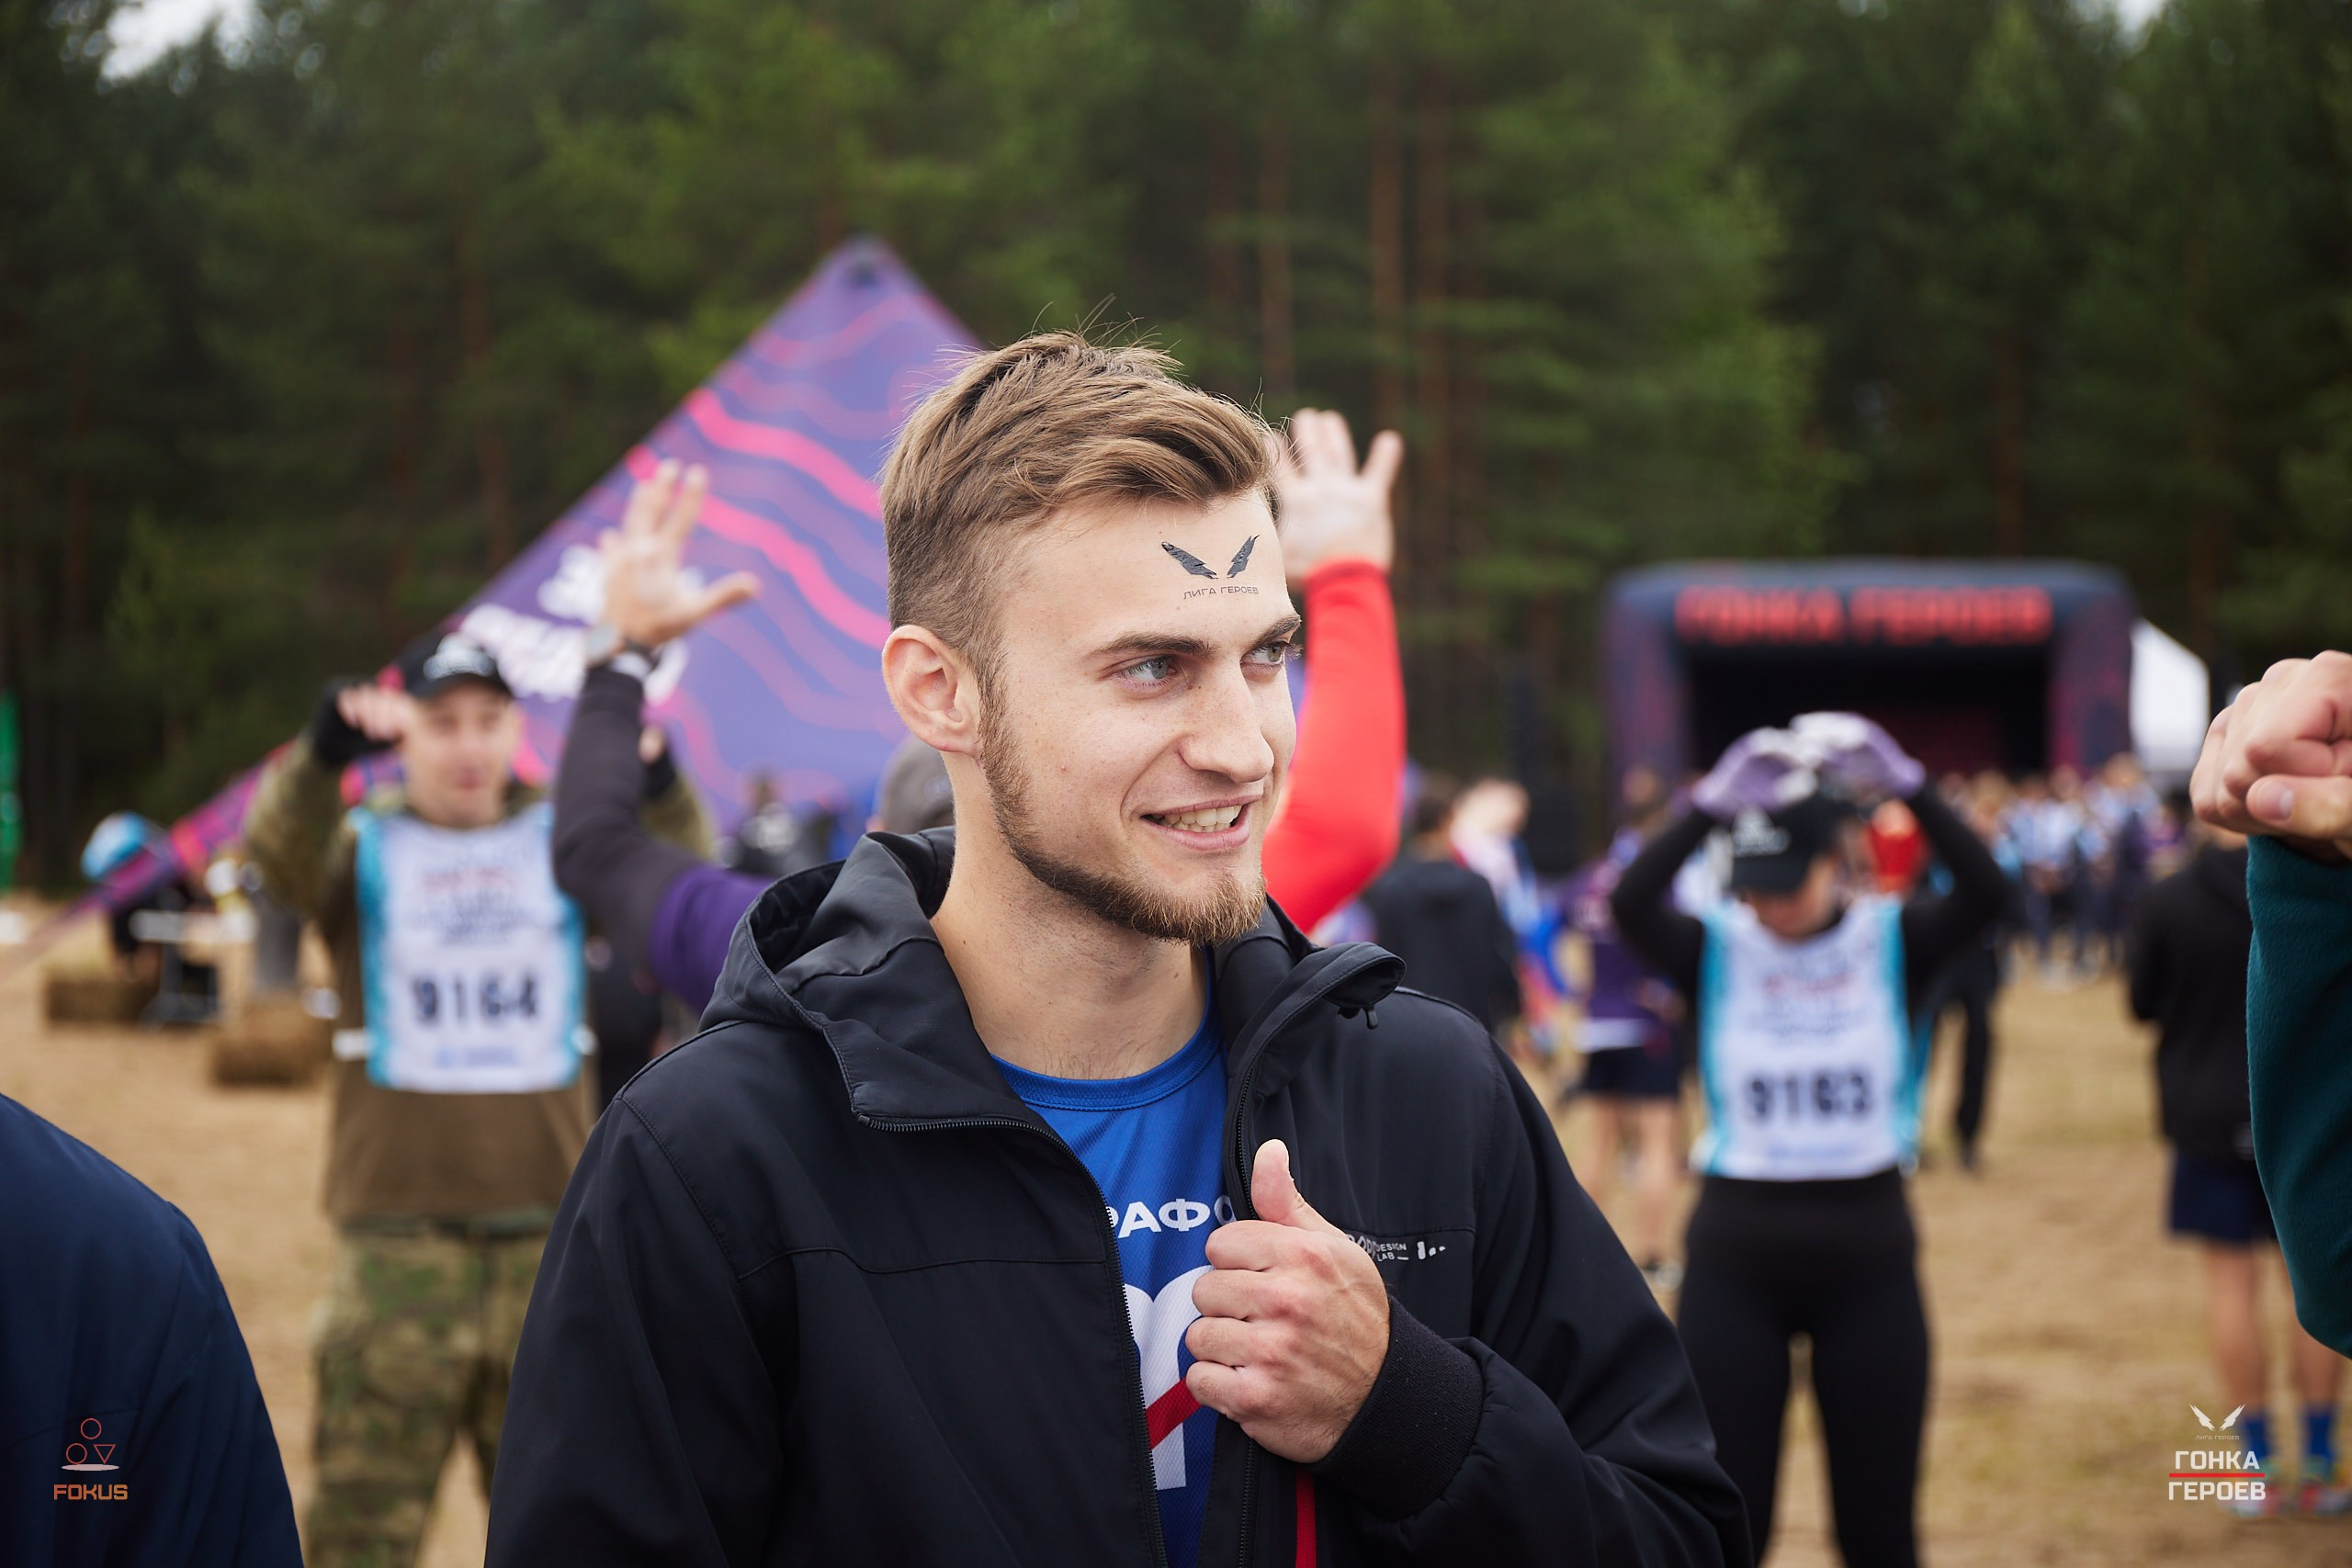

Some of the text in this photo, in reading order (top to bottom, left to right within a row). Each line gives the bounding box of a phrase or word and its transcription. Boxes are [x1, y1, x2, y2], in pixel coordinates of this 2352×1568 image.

[1183, 586, 1259, 599] ЛИГА ГЕРОЕВ
[412, 973, 538, 1023] 9164
[1747, 1070, 1871, 1122] 9163
[1375, 1243, 1408, 1252] DESIGN
